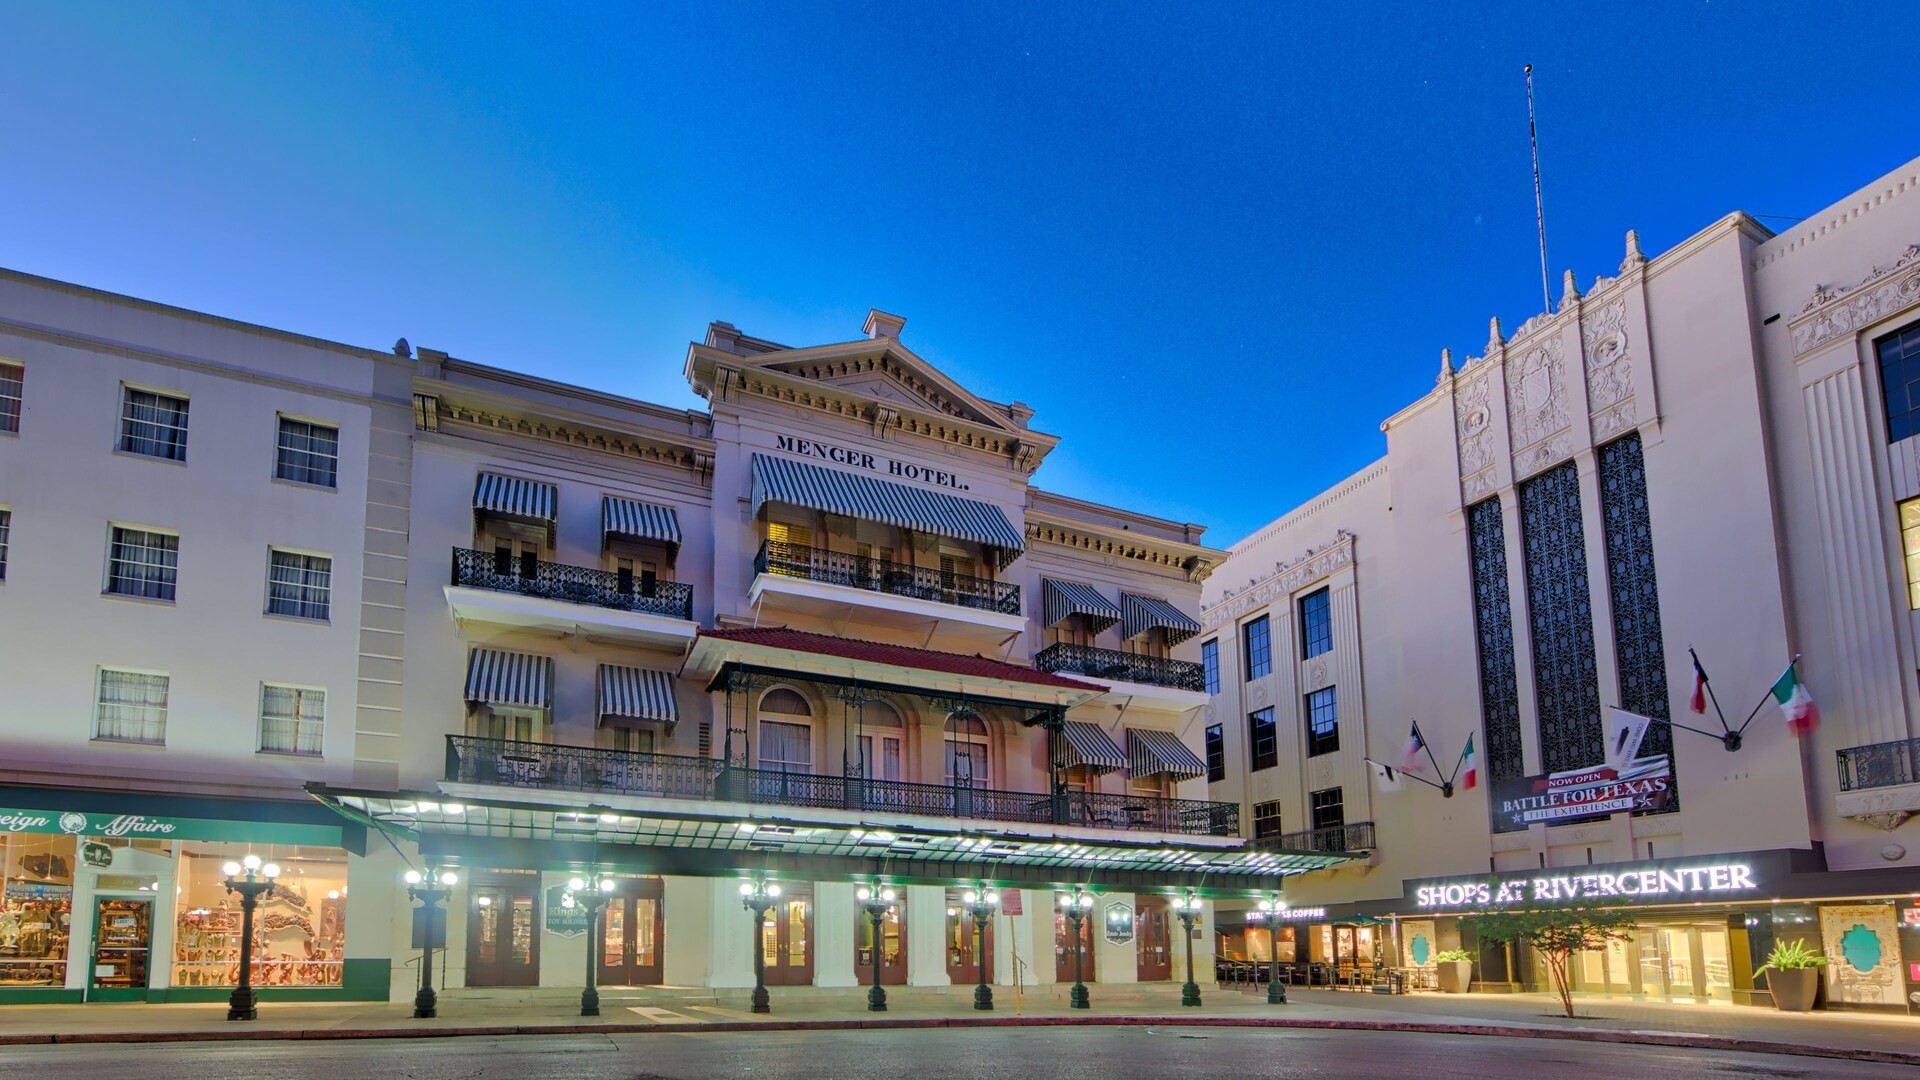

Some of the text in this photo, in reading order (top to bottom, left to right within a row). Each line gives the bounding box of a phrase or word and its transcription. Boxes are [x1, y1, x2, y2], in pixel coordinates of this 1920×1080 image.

[776, 435, 876, 470] MENGER
[1549, 772, 1601, 788] NOW OPEN
[1503, 777, 1667, 812] BATTLE FOR TEXAS
[1528, 800, 1628, 820] THE EXPERIENCE
[0, 812, 177, 836] eign Affairs
[1417, 865, 1757, 906] SHOPS AT RIVERCENTER
[1293, 908, 1325, 919] COFFEE
